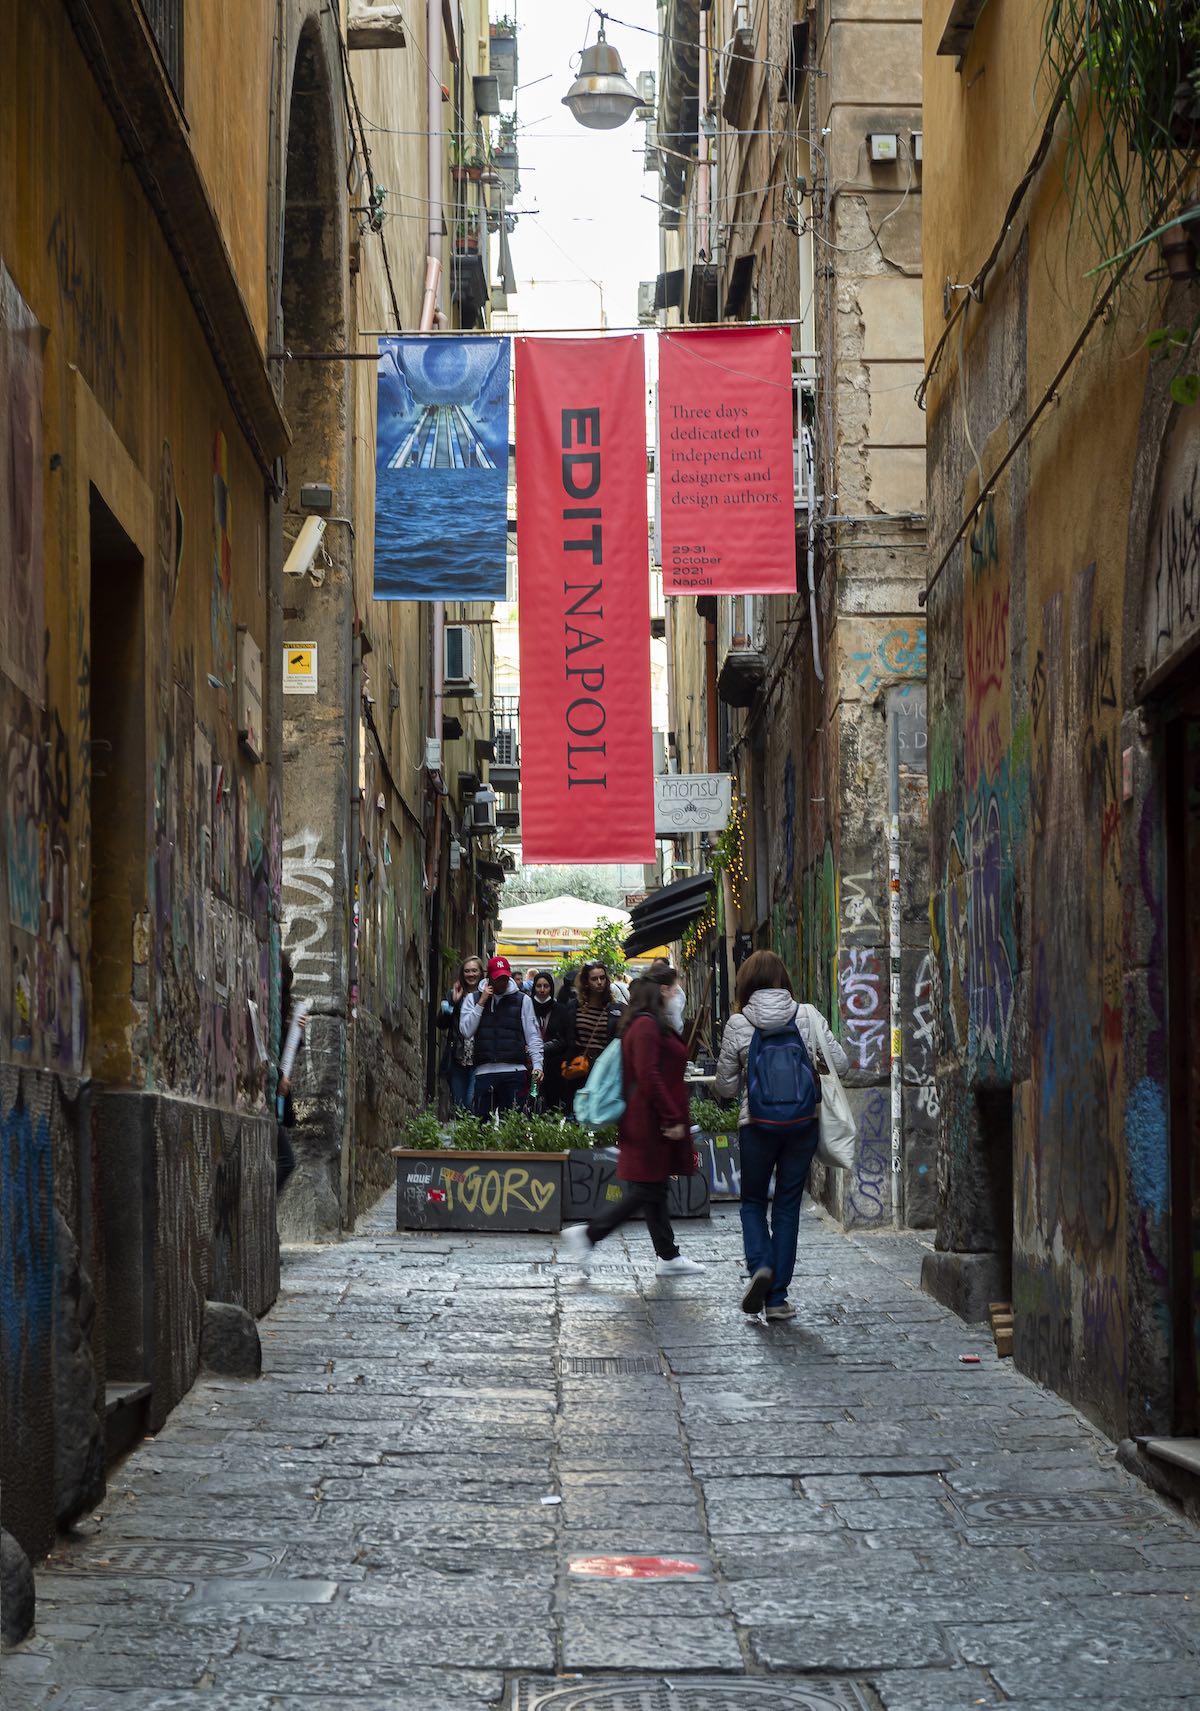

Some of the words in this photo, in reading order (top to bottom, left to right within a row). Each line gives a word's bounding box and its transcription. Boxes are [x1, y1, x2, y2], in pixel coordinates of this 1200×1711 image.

[669, 403, 711, 418] Three
[715, 403, 748, 421] days
[670, 425, 740, 440] dedicated
[745, 427, 759, 439] to
[671, 447, 763, 465] independent
[671, 469, 740, 487] designers
[744, 467, 771, 481] and
[561, 407, 602, 565] EDIT
[671, 491, 719, 509] design
[723, 489, 782, 504] authors.
[672, 545, 705, 554] 29-31
[672, 556, 721, 565] October
[672, 567, 703, 575] 2021
[672, 577, 713, 587] Napoli
[564, 579, 607, 790] NAPOLI
[900, 703, 927, 719] VIC
[914, 732, 927, 749] D
